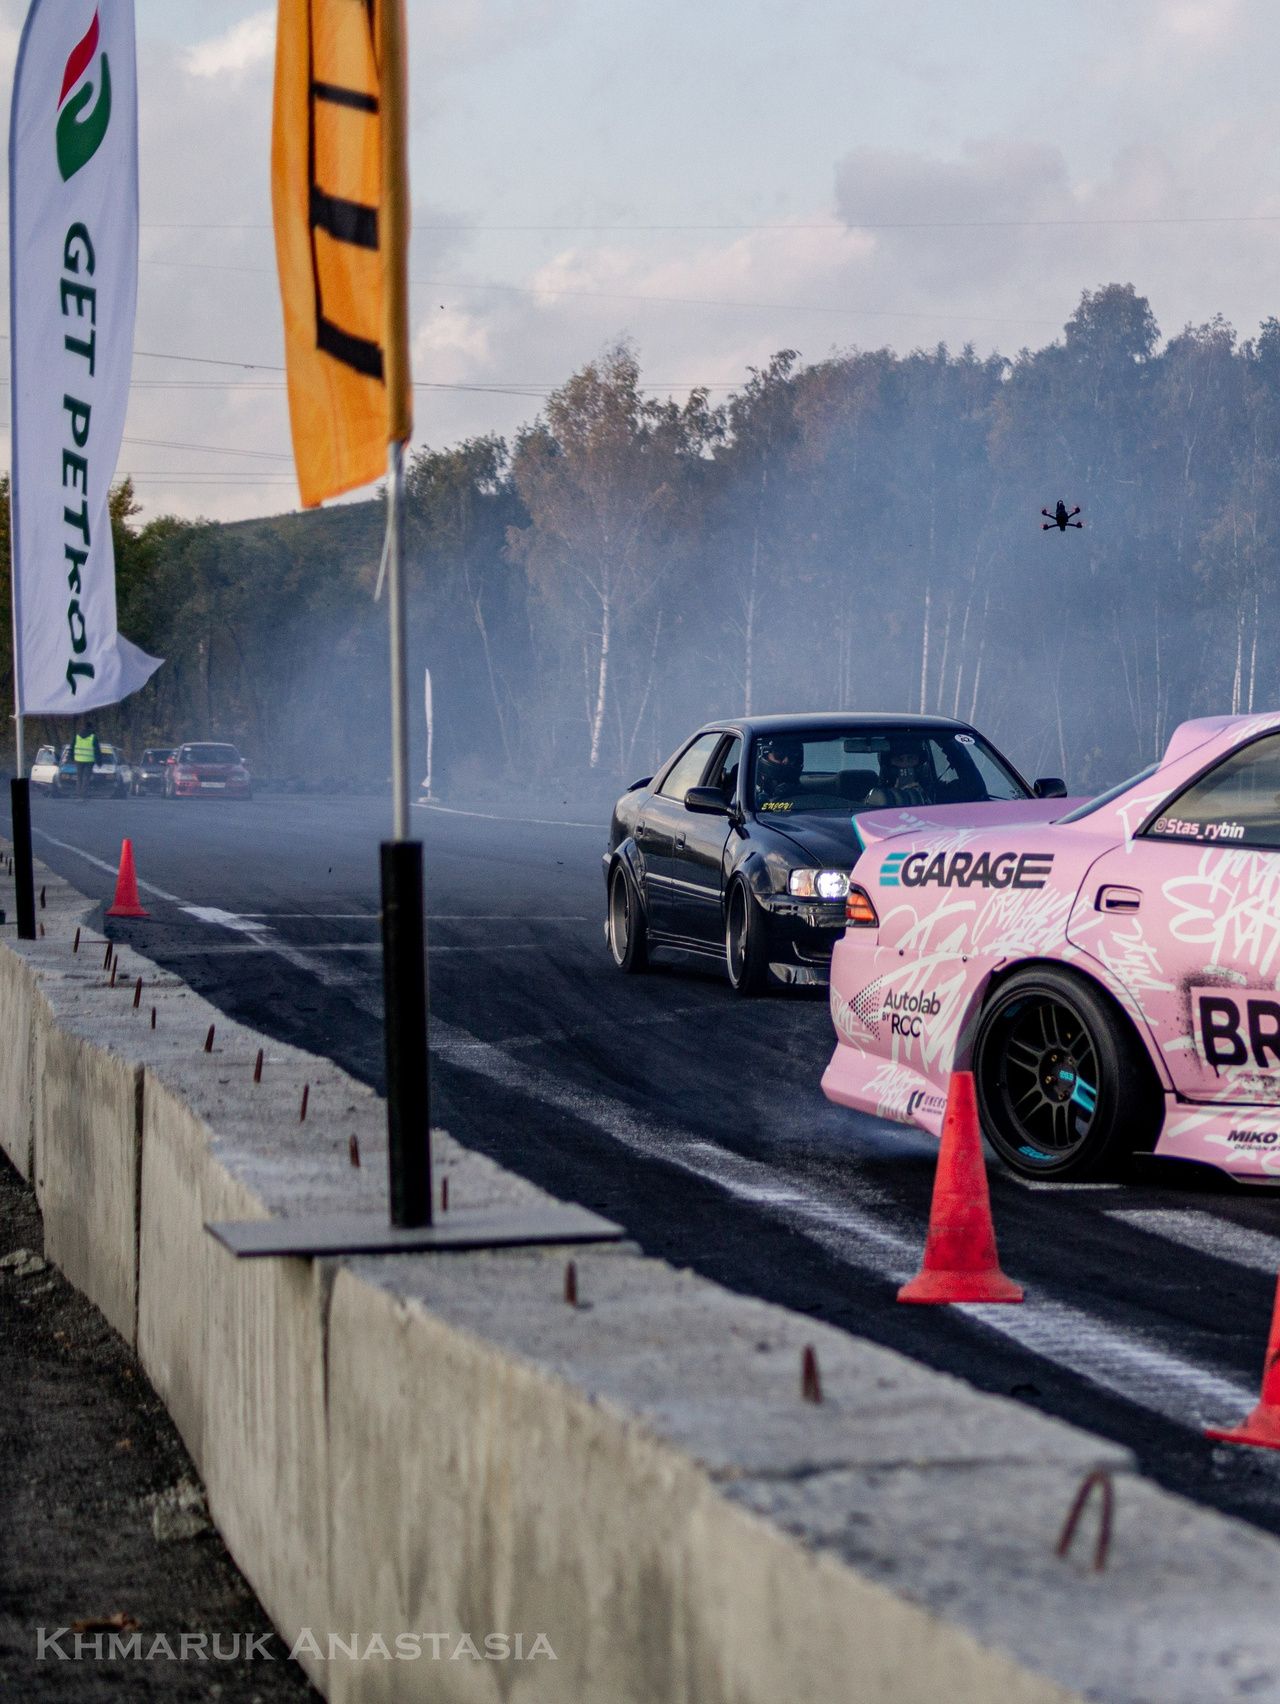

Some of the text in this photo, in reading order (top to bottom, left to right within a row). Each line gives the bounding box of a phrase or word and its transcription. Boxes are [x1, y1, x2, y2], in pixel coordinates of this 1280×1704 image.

[60, 221, 96, 696] GET PETROL
[883, 988, 941, 1016] Autolab
[891, 1013, 923, 1038] RCC
